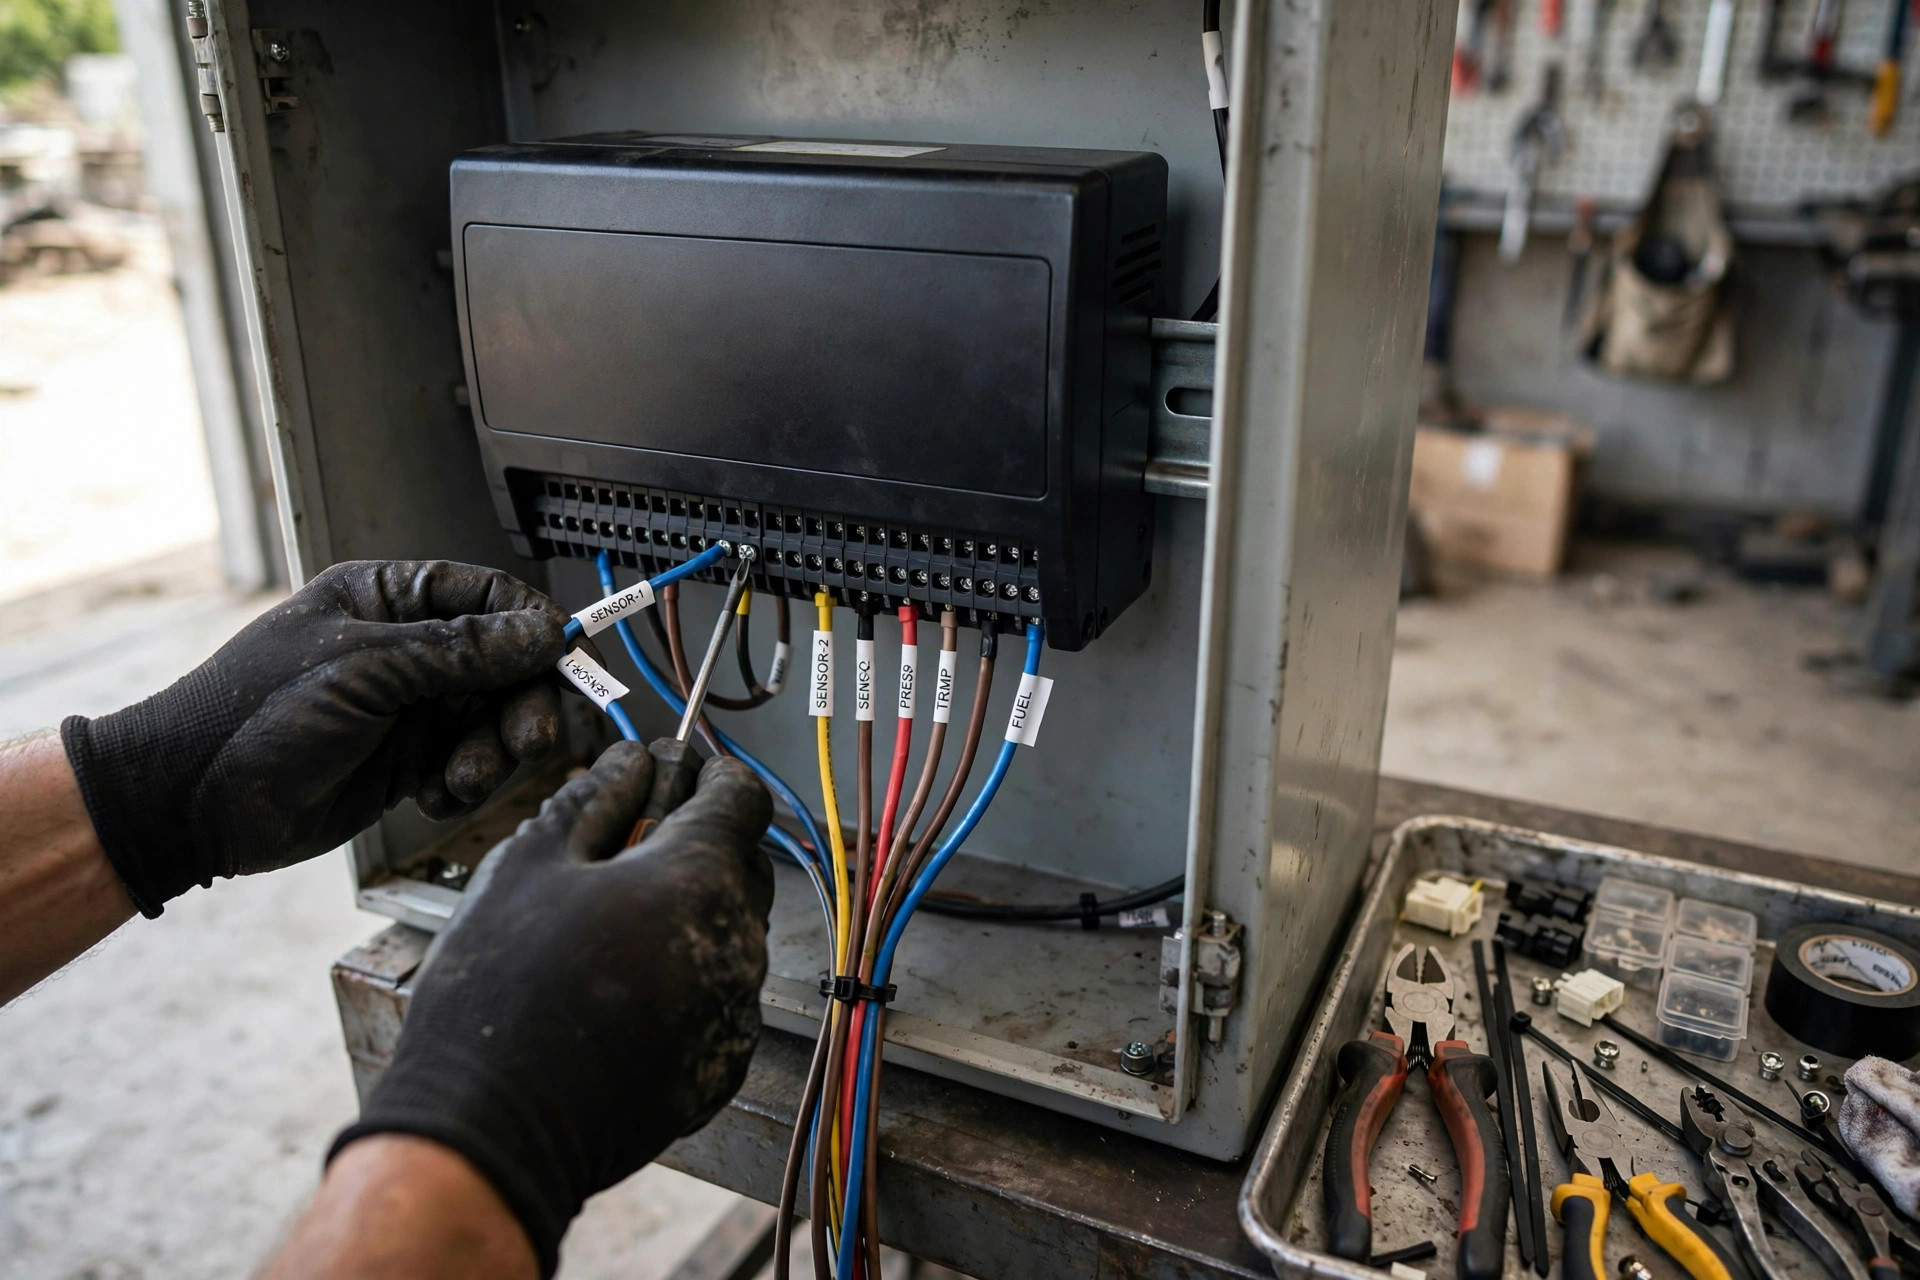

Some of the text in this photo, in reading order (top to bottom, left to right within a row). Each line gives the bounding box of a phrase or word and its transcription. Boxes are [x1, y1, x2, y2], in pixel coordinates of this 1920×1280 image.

[590, 588, 645, 623] SENSOR-1
[816, 638, 830, 709] SENSOR-2
[936, 667, 952, 711] TRMP
[1011, 691, 1033, 729] FUEL
